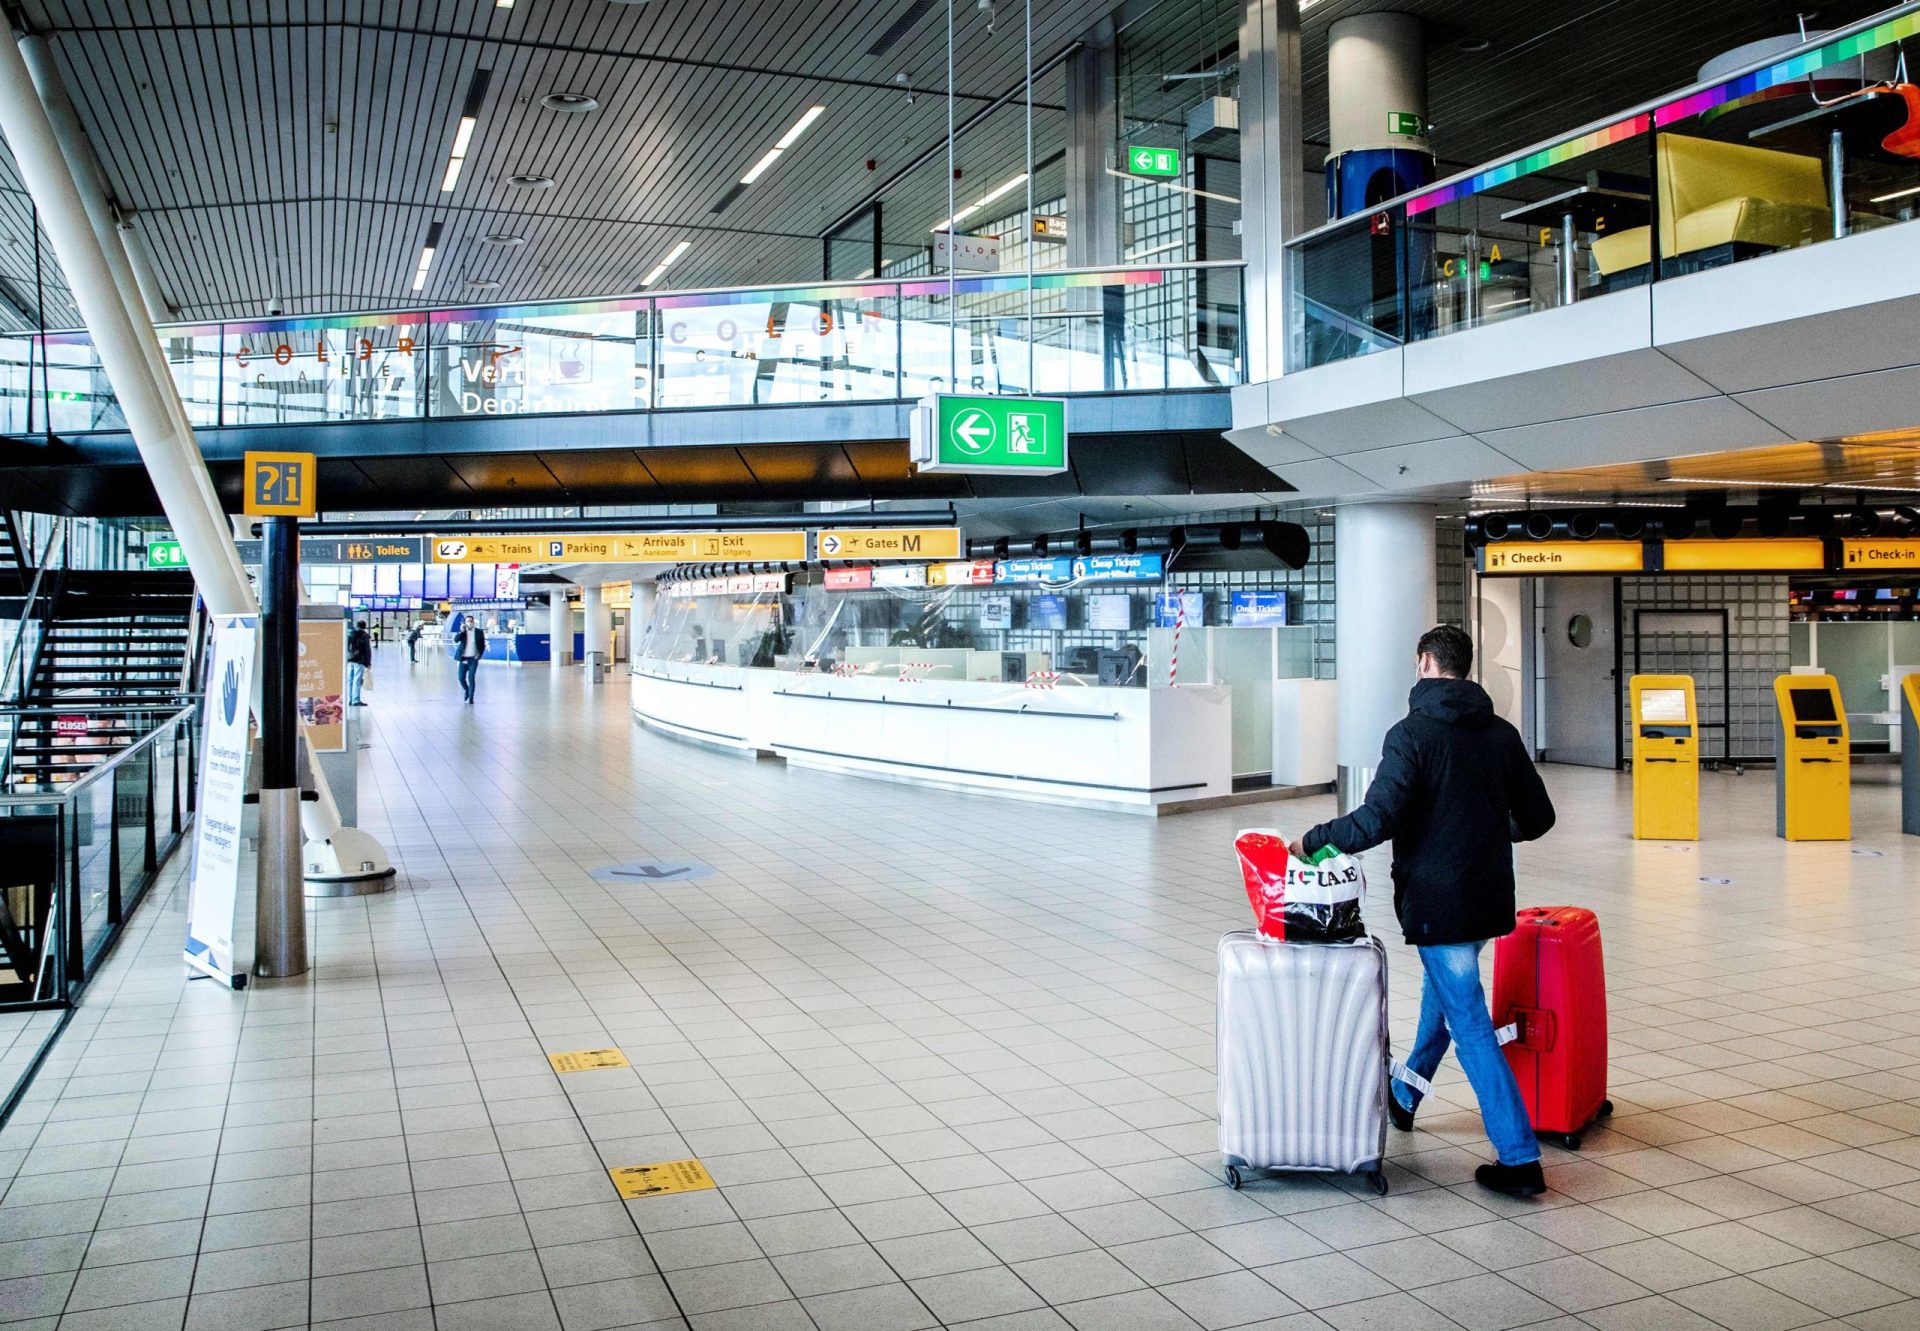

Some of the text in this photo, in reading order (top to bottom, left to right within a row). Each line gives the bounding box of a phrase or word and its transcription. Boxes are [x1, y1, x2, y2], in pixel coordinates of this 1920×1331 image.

[938, 242, 997, 256] COLOR
[669, 311, 882, 345] COLOR
[235, 337, 415, 368] COLOR
[256, 364, 391, 385] CAFE
[643, 537, 686, 547] Arrivals
[723, 536, 744, 546] Exit
[865, 535, 921, 552] Gates M
[376, 545, 410, 556] Toilets
[501, 544, 532, 554] Trains
[551, 542, 607, 556] P Parking
[643, 549, 679, 557] Aankomst
[723, 548, 752, 558] Uitgang
[1868, 548, 1916, 560] Check-in
[1091, 557, 1141, 569] Cheap Tickets
[1511, 551, 1562, 563] Check-in
[1010, 561, 1054, 571] Cheap Tickets
[1258, 605, 1282, 613] Tickets
[58, 721, 87, 730] CLOSED
[1287, 869, 1296, 885] I
